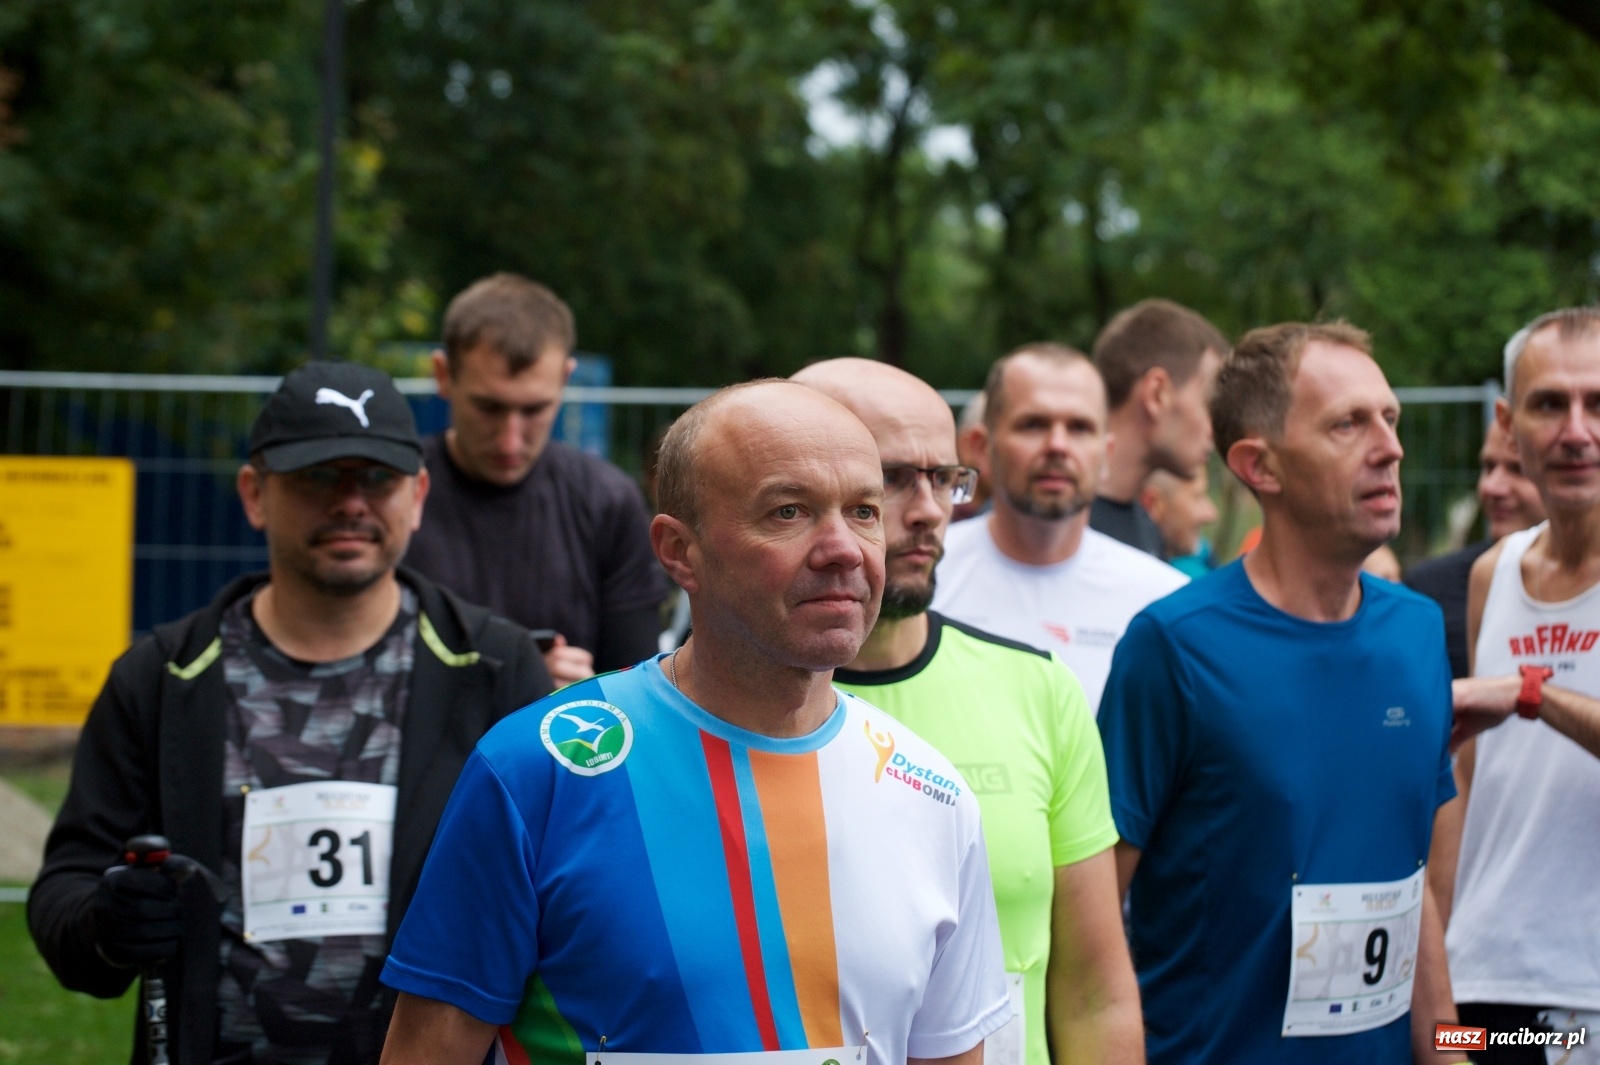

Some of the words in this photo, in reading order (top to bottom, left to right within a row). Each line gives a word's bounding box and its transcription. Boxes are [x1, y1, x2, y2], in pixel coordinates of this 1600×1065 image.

[541, 709, 560, 744] GMINA
[565, 700, 628, 723] LUBOMIA
[891, 752, 962, 797] Dystans
[308, 828, 374, 888] 31
[1363, 927, 1389, 986] 9
